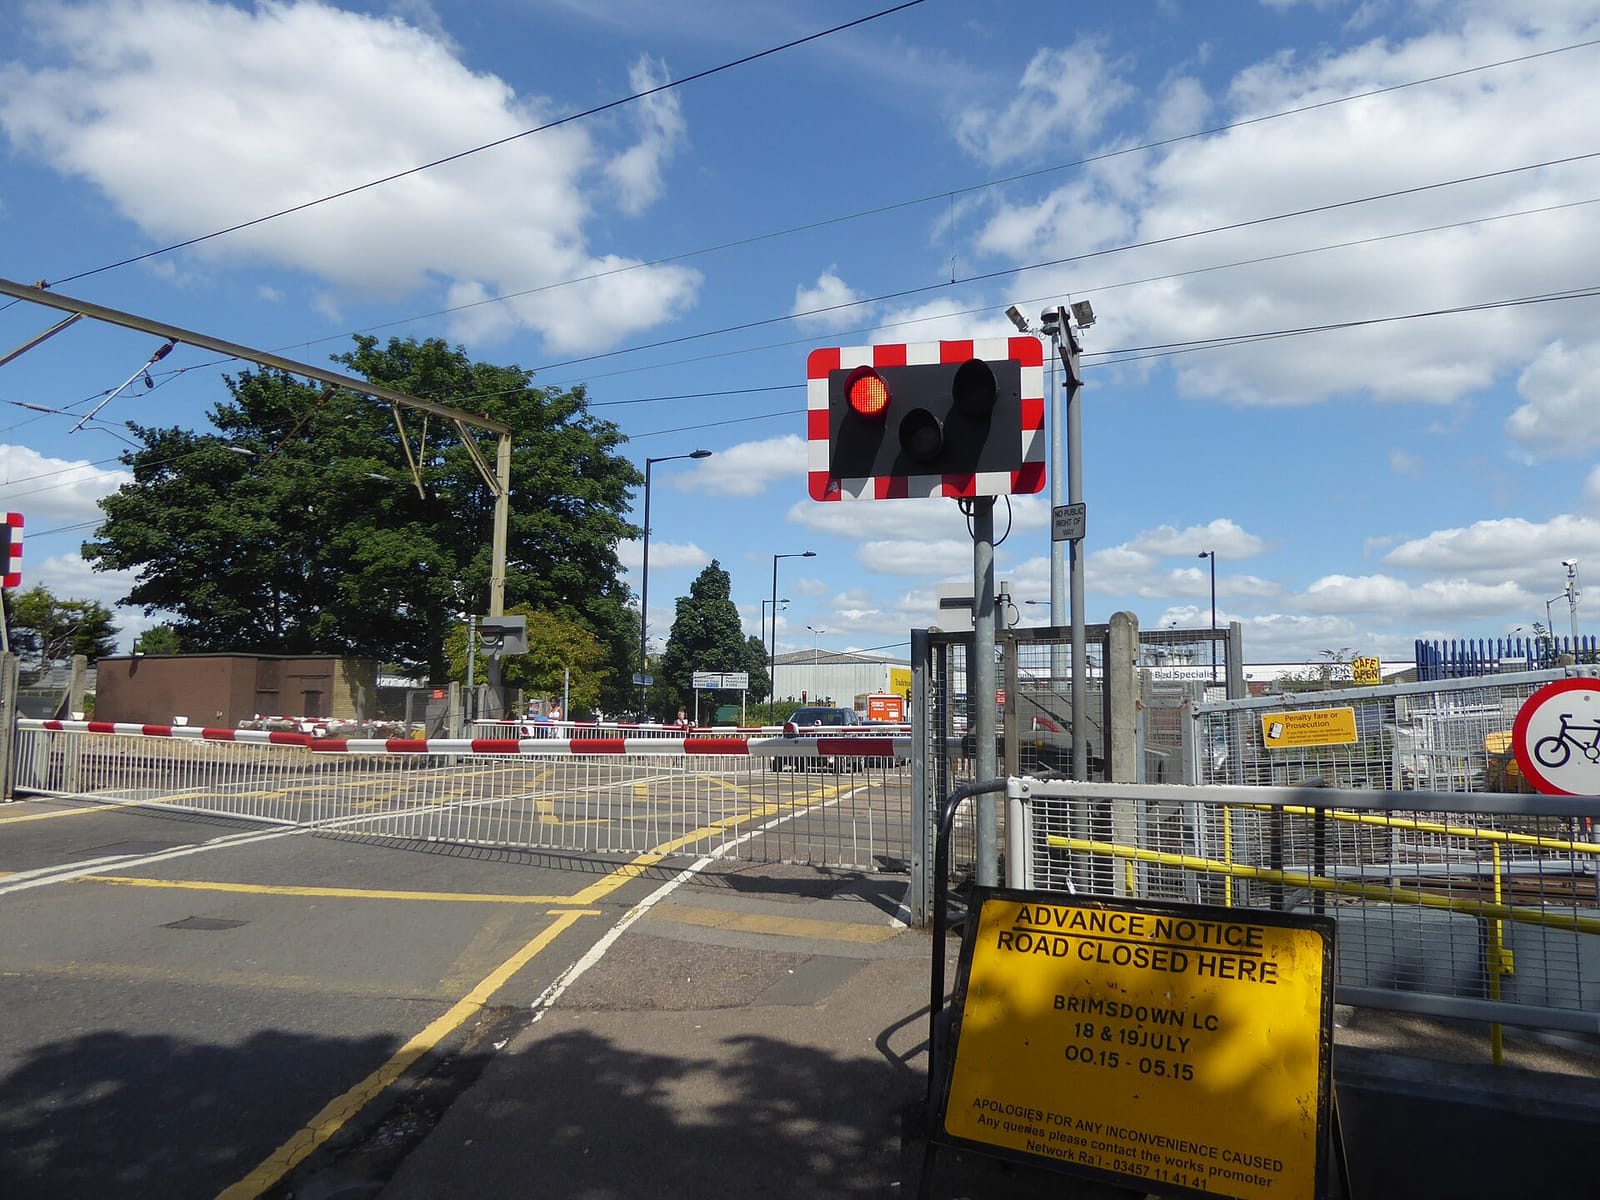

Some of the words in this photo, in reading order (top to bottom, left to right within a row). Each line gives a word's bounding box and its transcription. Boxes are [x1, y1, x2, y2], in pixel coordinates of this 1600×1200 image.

[1055, 510, 1063, 518] NO
[1064, 507, 1083, 516] PUBLIC
[1056, 519, 1072, 528] RIGHT
[1073, 517, 1081, 525] OF
[1063, 528, 1074, 536] WAY
[1353, 658, 1376, 669] CAFE
[1353, 669, 1378, 681] OPEN
[1285, 713, 1312, 723] Penalty
[1314, 712, 1328, 720] fare
[1286, 720, 1330, 729] Prosecution
[1015, 905, 1144, 936] ADVANCE
[1155, 919, 1264, 949] NOTICE
[997, 930, 1069, 958] ROAD
[1078, 941, 1188, 973] CLOSED
[1198, 955, 1278, 984] HERE
[1053, 995, 1185, 1027] BRIMSDOWN
[1192, 1013, 1219, 1031] LC
[1074, 1022, 1094, 1038] 18
[1100, 1026, 1113, 1042] &
[1139, 1057, 1194, 1081] 05.15
[972, 1097, 1043, 1121] APOLOGIES
[1046, 1113, 1072, 1128] FOR
[1075, 1119, 1102, 1134] ANY
[1105, 1126, 1218, 1159] INCONVENIENCE
[1222, 1149, 1283, 1172] CAUSED
[977, 1114, 1000, 1130] Any
[1003, 1121, 1045, 1138] queries
[1048, 1129, 1088, 1147] please
[1091, 1138, 1137, 1158] contact
[1141, 1150, 1161, 1163] the
[1165, 1155, 1205, 1173] works
[1208, 1165, 1273, 1188] promoter
[1026, 1139, 1075, 1160] Network
[1113, 1159, 1150, 1176] 03457
[1154, 1168, 1168, 1182] 11
[1172, 1172, 1187, 1186] 41
[1192, 1178, 1207, 1190] 41
